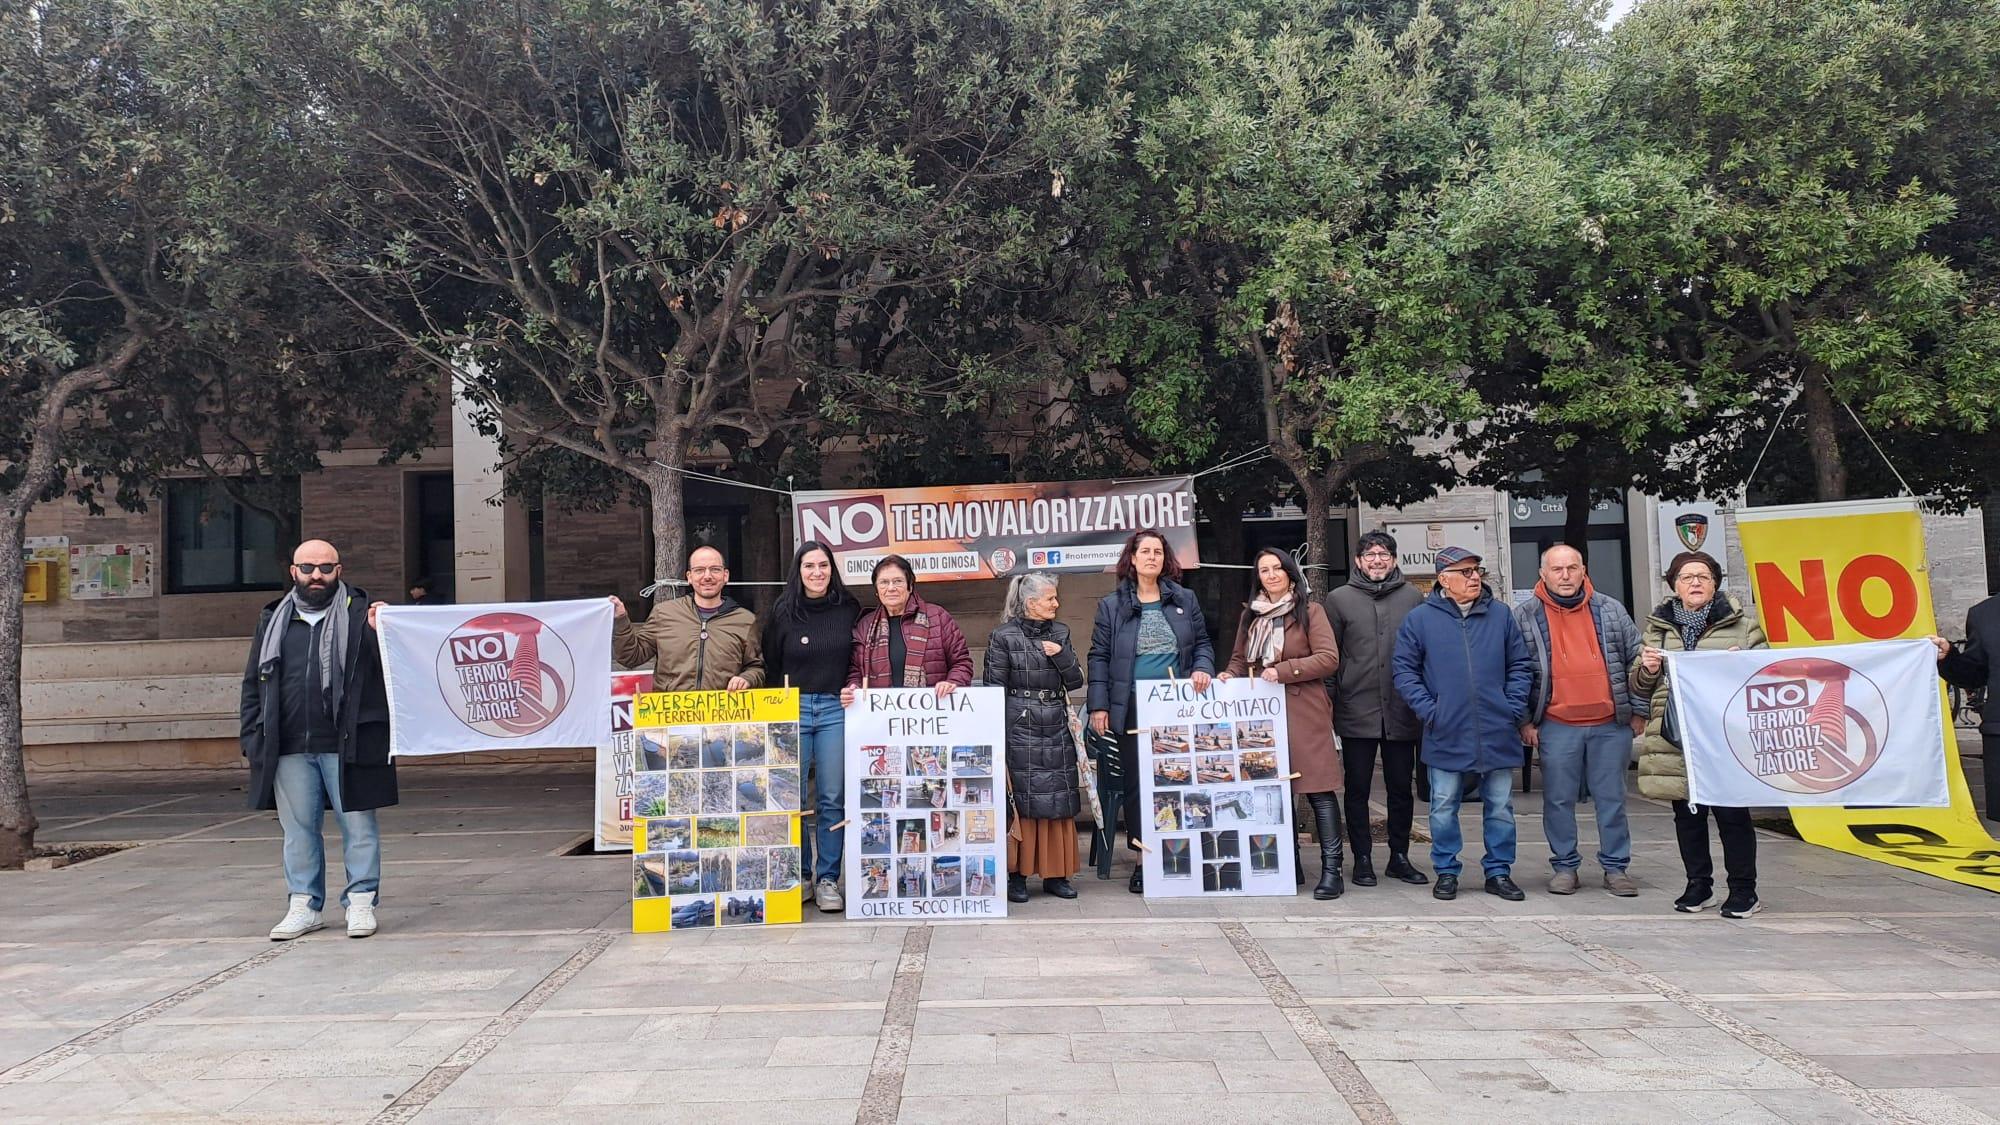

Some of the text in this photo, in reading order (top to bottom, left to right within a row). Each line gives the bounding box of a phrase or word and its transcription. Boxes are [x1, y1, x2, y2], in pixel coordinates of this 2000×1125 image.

[801, 490, 1190, 546] NO TERMOVALORIZZATORE
[1541, 503, 1563, 512] Città
[930, 556, 940, 569] DI
[941, 555, 977, 569] GINOSA
[1065, 551, 1121, 560] #notermovalo
[1402, 552, 1436, 565] MUNI
[1754, 554, 1918, 643] NO
[453, 636, 503, 662] NO
[455, 662, 508, 686] TERMO
[460, 680, 524, 703] VALORIZ
[639, 691, 755, 713] SVERSAMENTI
[869, 692, 974, 713] RACCOLTA
[1148, 683, 1216, 702] AZIONI
[1750, 684, 1806, 709] NO
[466, 700, 520, 723] ZATORE
[656, 708, 751, 724] TERRENI PRIVATI
[1177, 696, 1281, 719] del COMITATO
[889, 716, 950, 737] FIRME
[1747, 708, 1806, 731] TERMO
[1749, 724, 1824, 753] VALORIZ
[1755, 748, 1819, 776] ZATORE
[861, 898, 993, 917] OLTRE 5000 FIRME
